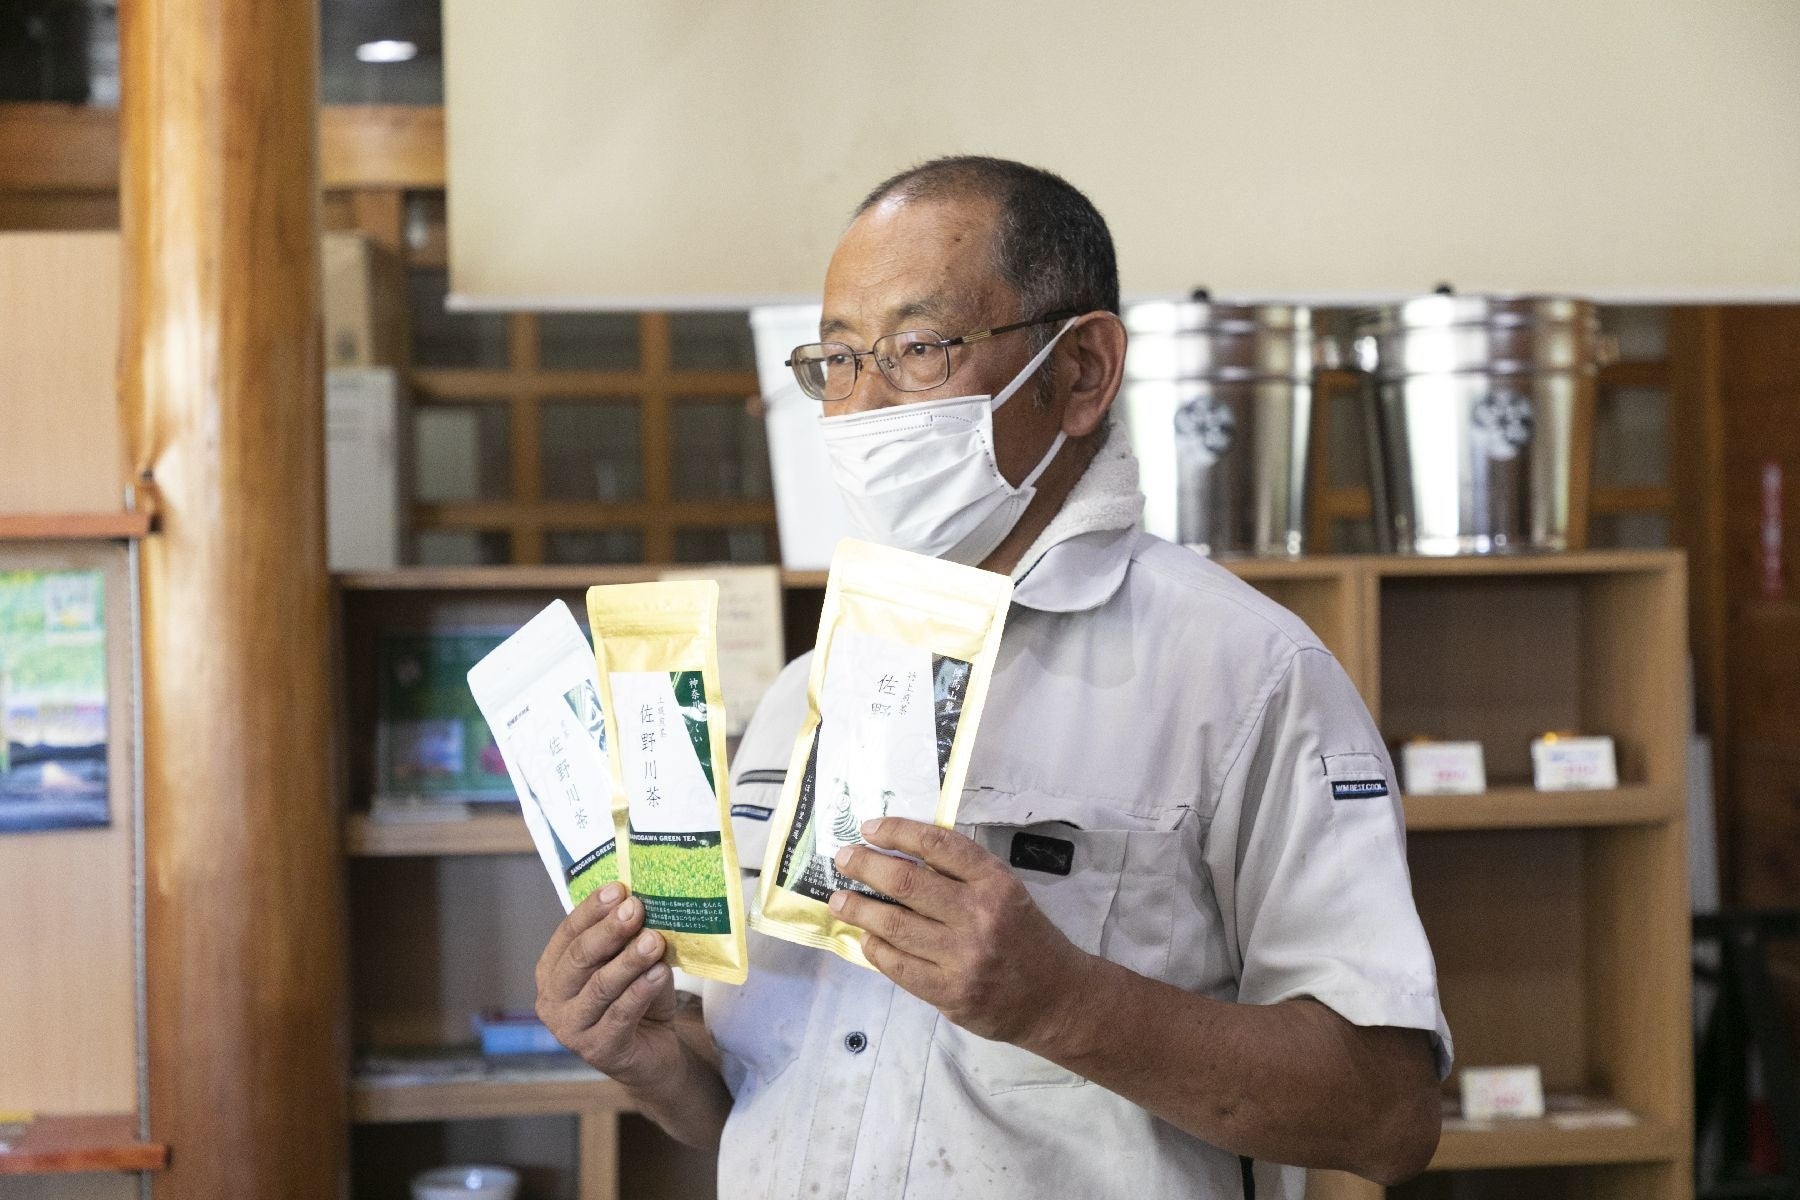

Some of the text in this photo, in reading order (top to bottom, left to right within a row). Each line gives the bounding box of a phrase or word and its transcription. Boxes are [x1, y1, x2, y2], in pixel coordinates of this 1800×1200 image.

[550, 736, 588, 829] 佐野川茶
[641, 704, 661, 808] 佐野川茶
[570, 854, 596, 876] SANOGAWA
